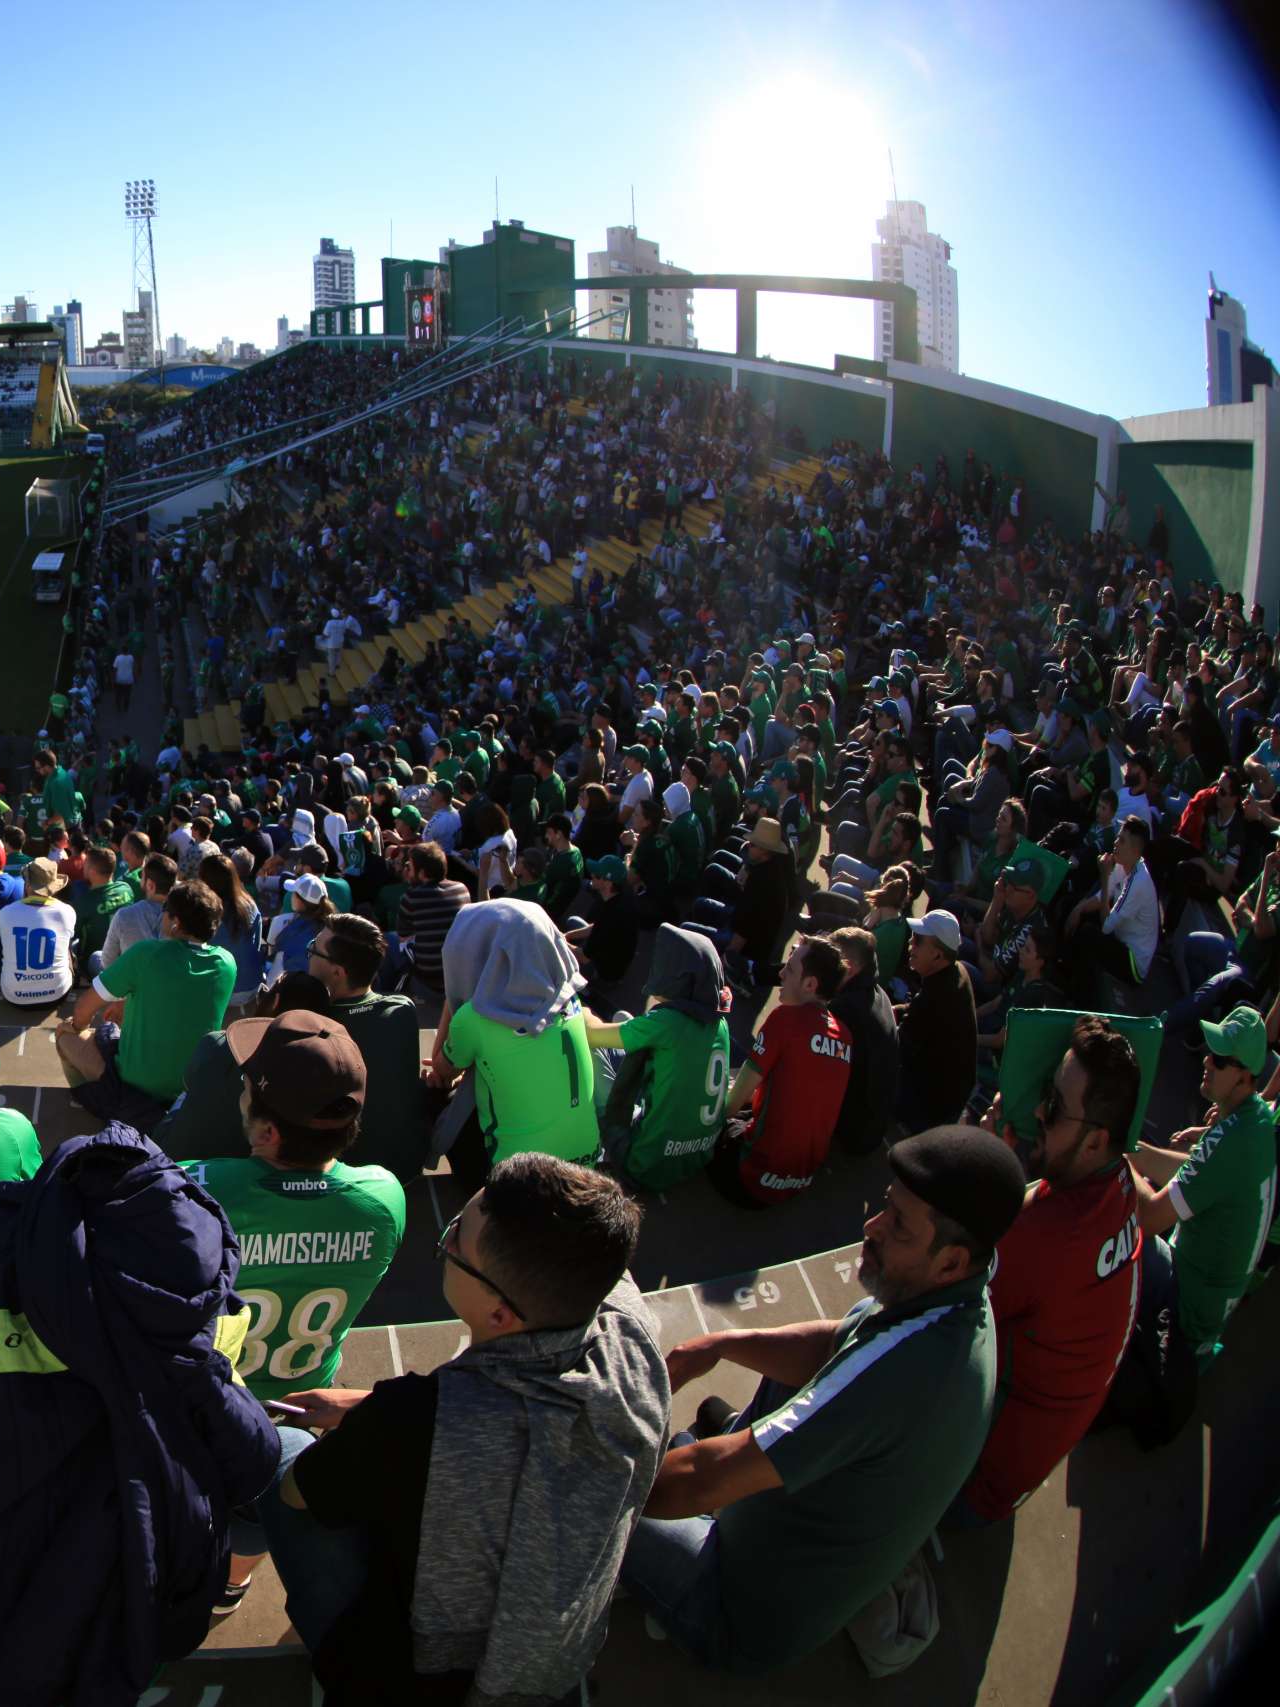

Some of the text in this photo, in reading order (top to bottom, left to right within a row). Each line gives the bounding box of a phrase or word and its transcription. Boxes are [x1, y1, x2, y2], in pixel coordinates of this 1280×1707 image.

[13, 926, 57, 972] 10
[348, 1004, 374, 1015] umbro
[810, 1034, 852, 1064] CAIXA
[699, 1049, 728, 1126] 9
[282, 1178, 328, 1193] umbro
[236, 1231, 375, 1266] VAMOSCHAPE
[733, 1280, 782, 1312] 65
